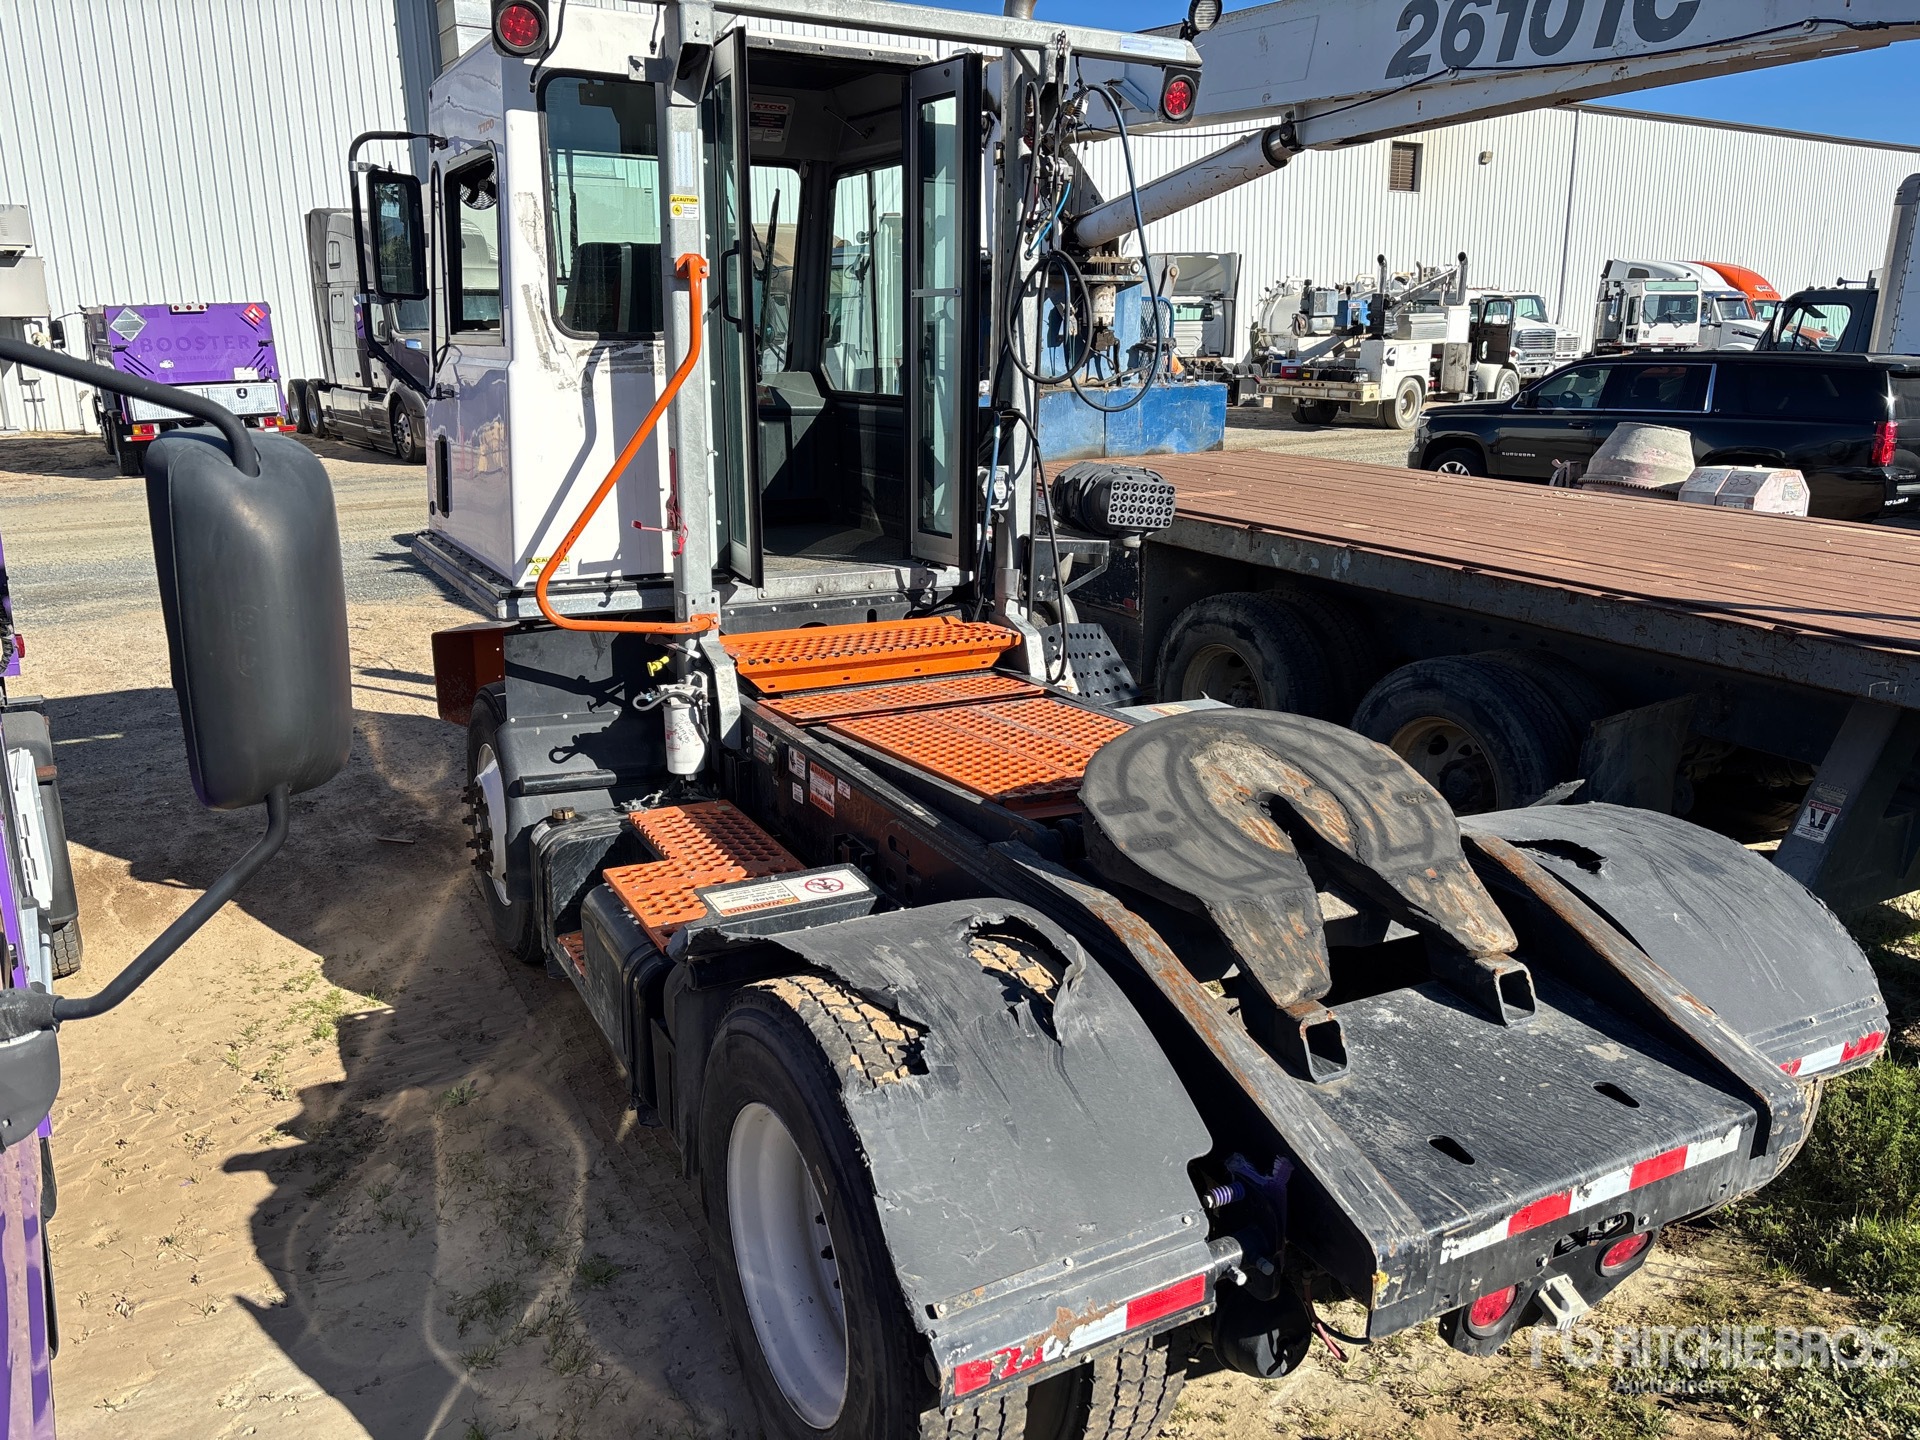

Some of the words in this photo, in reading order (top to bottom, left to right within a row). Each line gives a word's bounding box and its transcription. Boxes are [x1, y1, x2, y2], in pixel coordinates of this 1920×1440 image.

[477, 118, 495, 135] TICO
[139, 335, 251, 353] BOOSTER
[728, 901, 784, 913] WARNING
